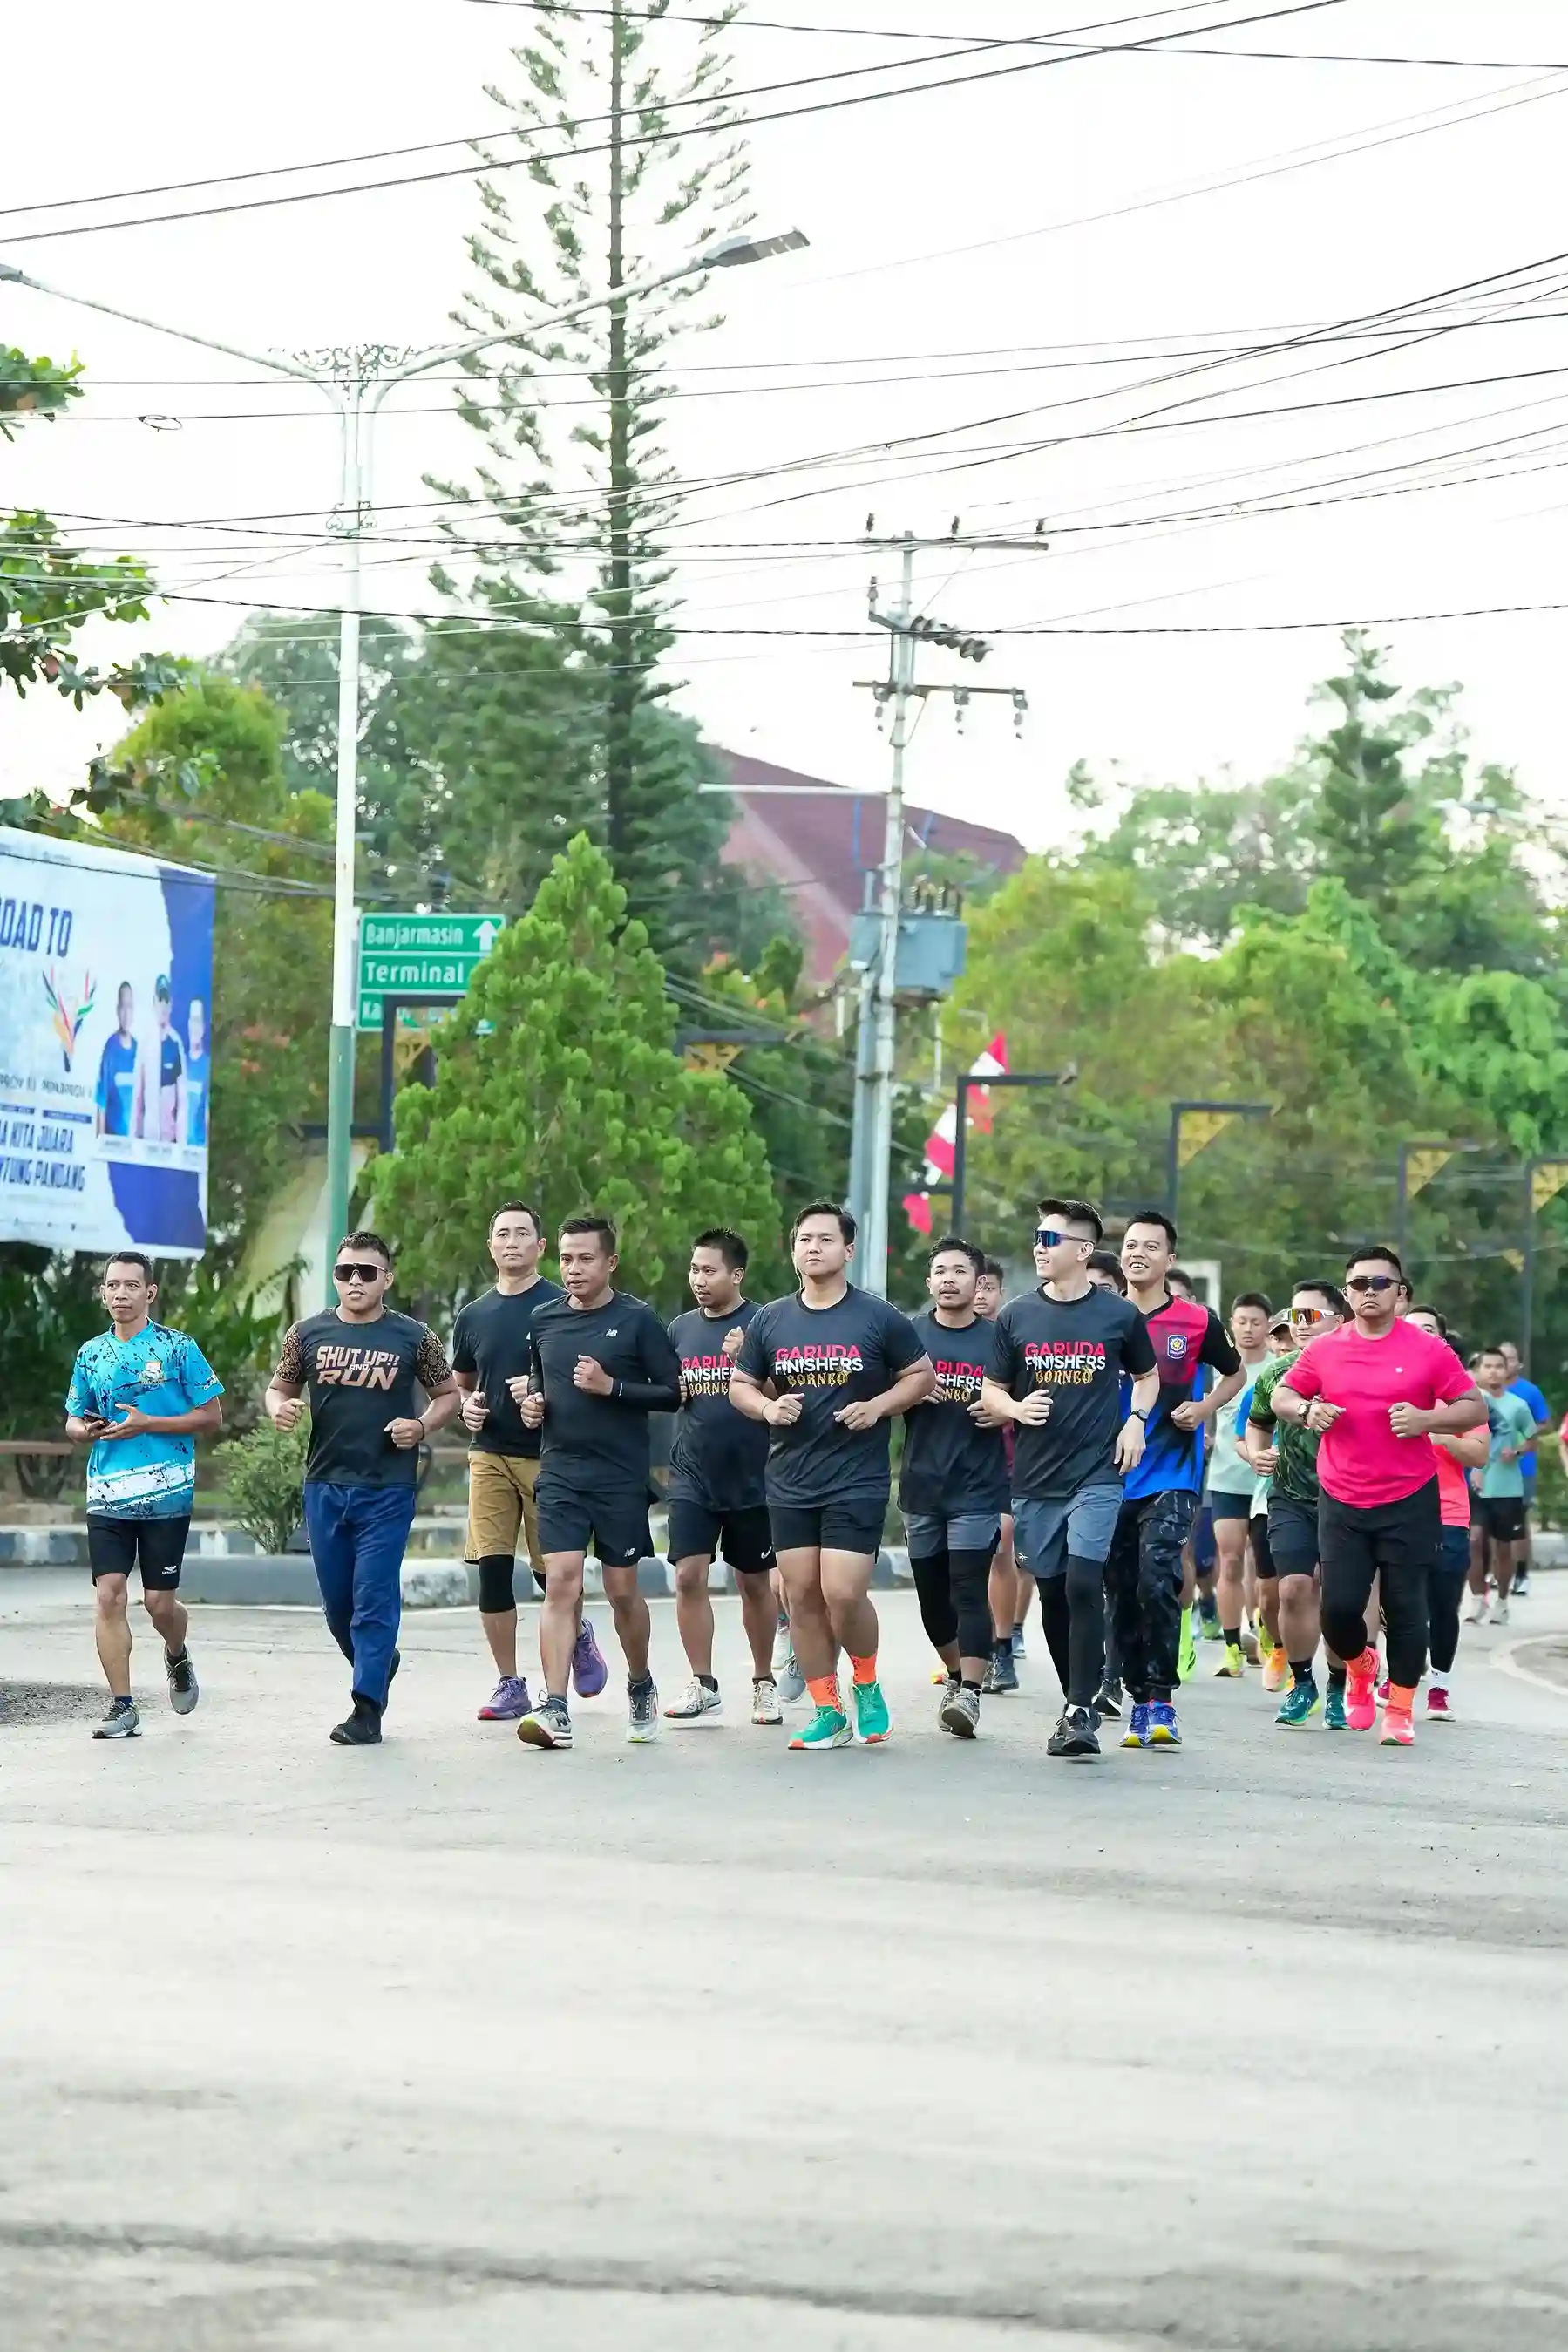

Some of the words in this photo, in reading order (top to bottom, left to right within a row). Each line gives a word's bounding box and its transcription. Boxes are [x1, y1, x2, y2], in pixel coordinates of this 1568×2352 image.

[0, 896, 44, 952] OAD
[46, 907, 72, 958] TO
[365, 922, 464, 949] Banjarmasin
[365, 961, 465, 984] Terminal
[776, 1344, 861, 1362] GARUDA
[1025, 1341, 1106, 1356] GARUDA
[316, 1345, 362, 1370] SHUT
[363, 1349, 401, 1366] UP!!
[682, 1355, 735, 1371] GARUD
[775, 1356, 864, 1375] FINISHERS
[1024, 1353, 1107, 1370] FINISHERS
[936, 1360, 984, 1377] RUDA
[316, 1366, 399, 1390] RUN
[786, 1371, 852, 1388] BORNEO
[1035, 1369, 1094, 1386] BORNEO
[689, 1381, 730, 1397] BORNE
